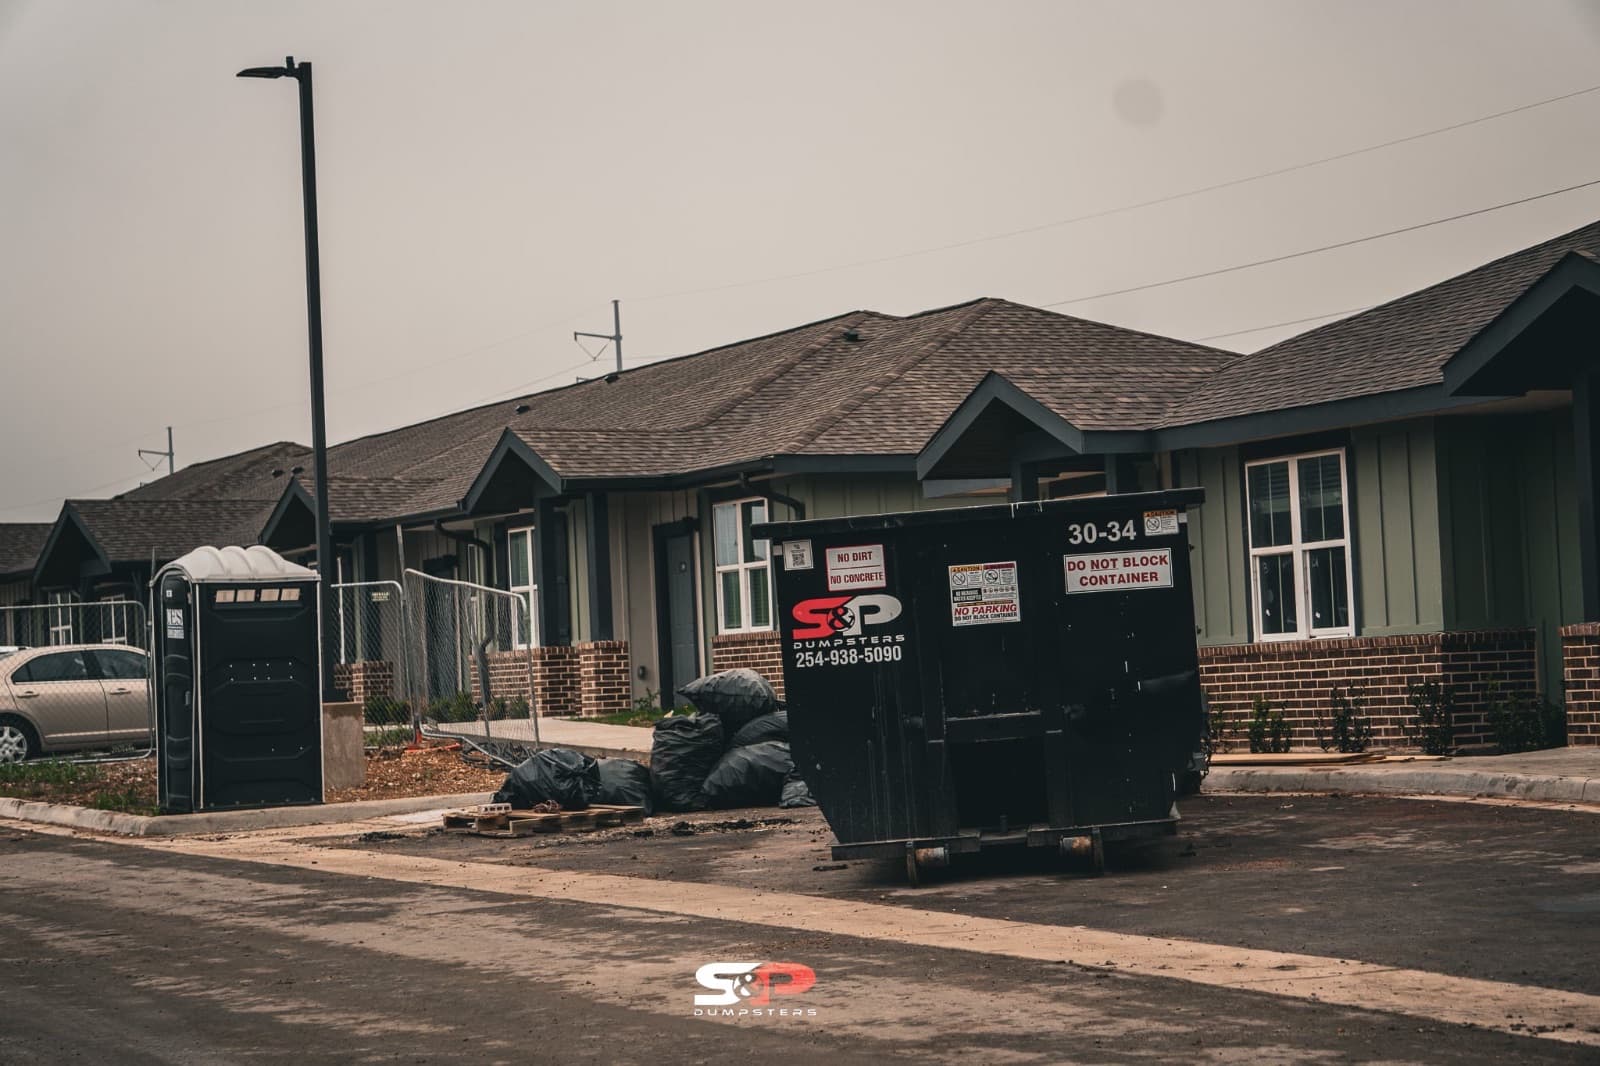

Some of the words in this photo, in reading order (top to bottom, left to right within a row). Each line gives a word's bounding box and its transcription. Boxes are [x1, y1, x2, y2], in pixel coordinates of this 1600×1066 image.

[1068, 519, 1137, 545] 30-34
[837, 553, 849, 563] NO
[853, 551, 873, 562] DIRT
[1067, 560, 1086, 571] DO
[1090, 558, 1118, 570] NOT
[1123, 555, 1168, 568] BLOCK
[830, 575, 842, 584] NO
[844, 572, 884, 583] CONCRETE
[1079, 571, 1159, 587] CONTAINER
[792, 594, 903, 640] S&P
[954, 607, 969, 616] NO
[972, 604, 1017, 615] PARKING
[793, 634, 905, 650] DUMPSTERS
[795, 645, 902, 668] 254-938-5090
